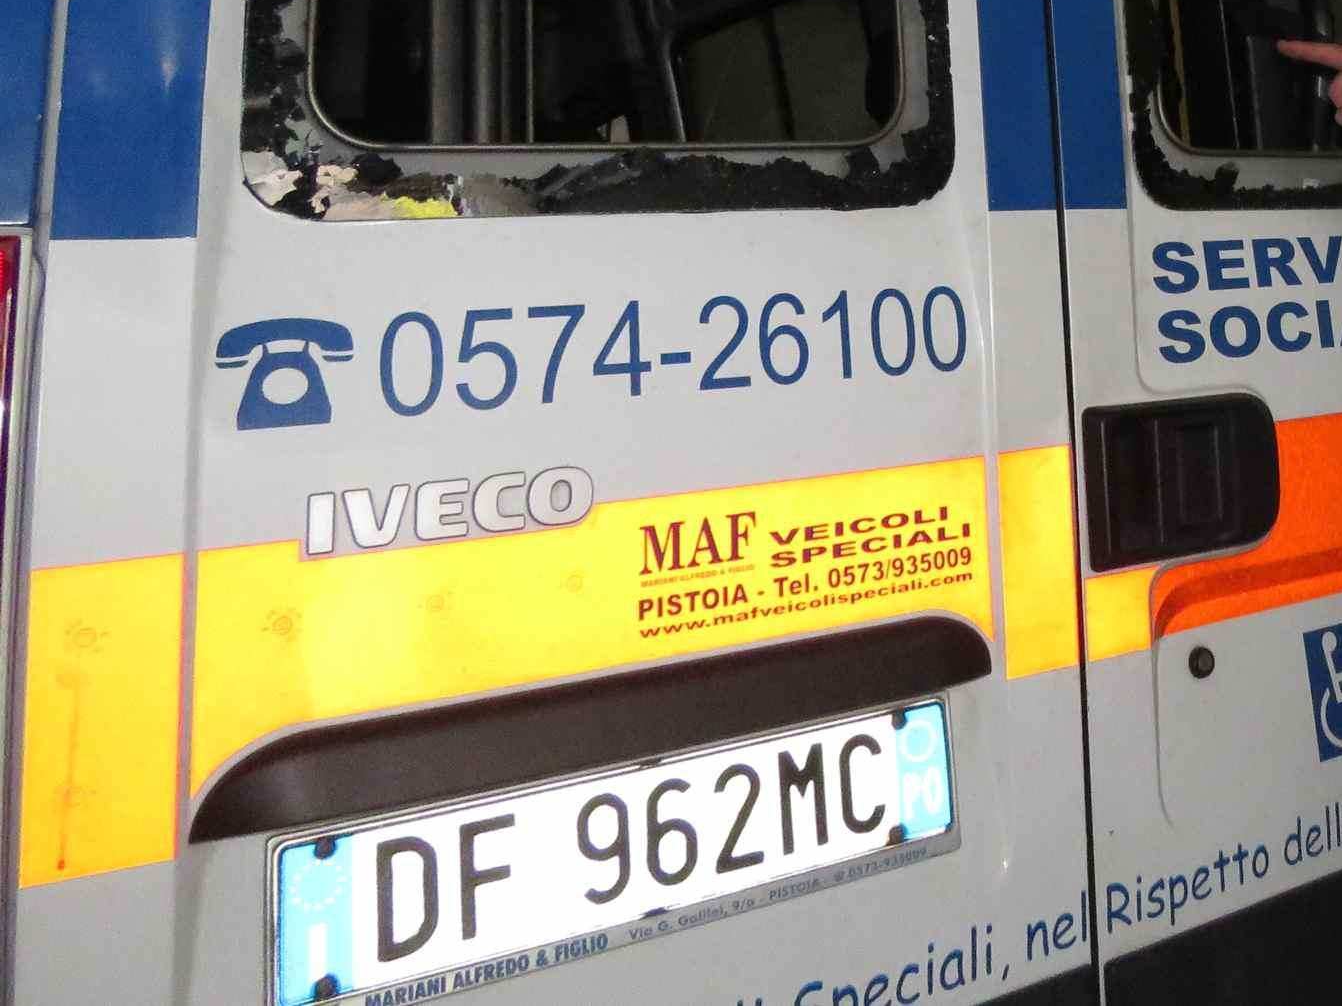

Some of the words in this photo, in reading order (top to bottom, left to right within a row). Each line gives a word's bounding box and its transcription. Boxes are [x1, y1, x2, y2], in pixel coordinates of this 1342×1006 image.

[379, 285, 967, 418] 0574-26100
[304, 465, 595, 557] IVECO
[639, 511, 757, 575] MAF
[769, 506, 949, 546] VEICOLI
[770, 523, 971, 568] SPECIALI
[638, 584, 748, 621] PISTOIA
[774, 573, 818, 599] Tel.
[827, 547, 972, 589] 0573/935009
[639, 572, 974, 638] www.mafveicolispeciali.com
[375, 814, 517, 964] DF
[576, 733, 886, 905] 962MC
[364, 976, 447, 1006] MARIANI
[453, 955, 530, 991] ALFREDO
[536, 950, 548, 967] &
[555, 933, 609, 963] FIGLIO
[629, 926, 653, 941] Via
[657, 920, 672, 932] G.
[768, 878, 820, 900] PISTOIA
[1026, 891, 1088, 961] nel
[1105, 842, 1270, 934] Rispetto
